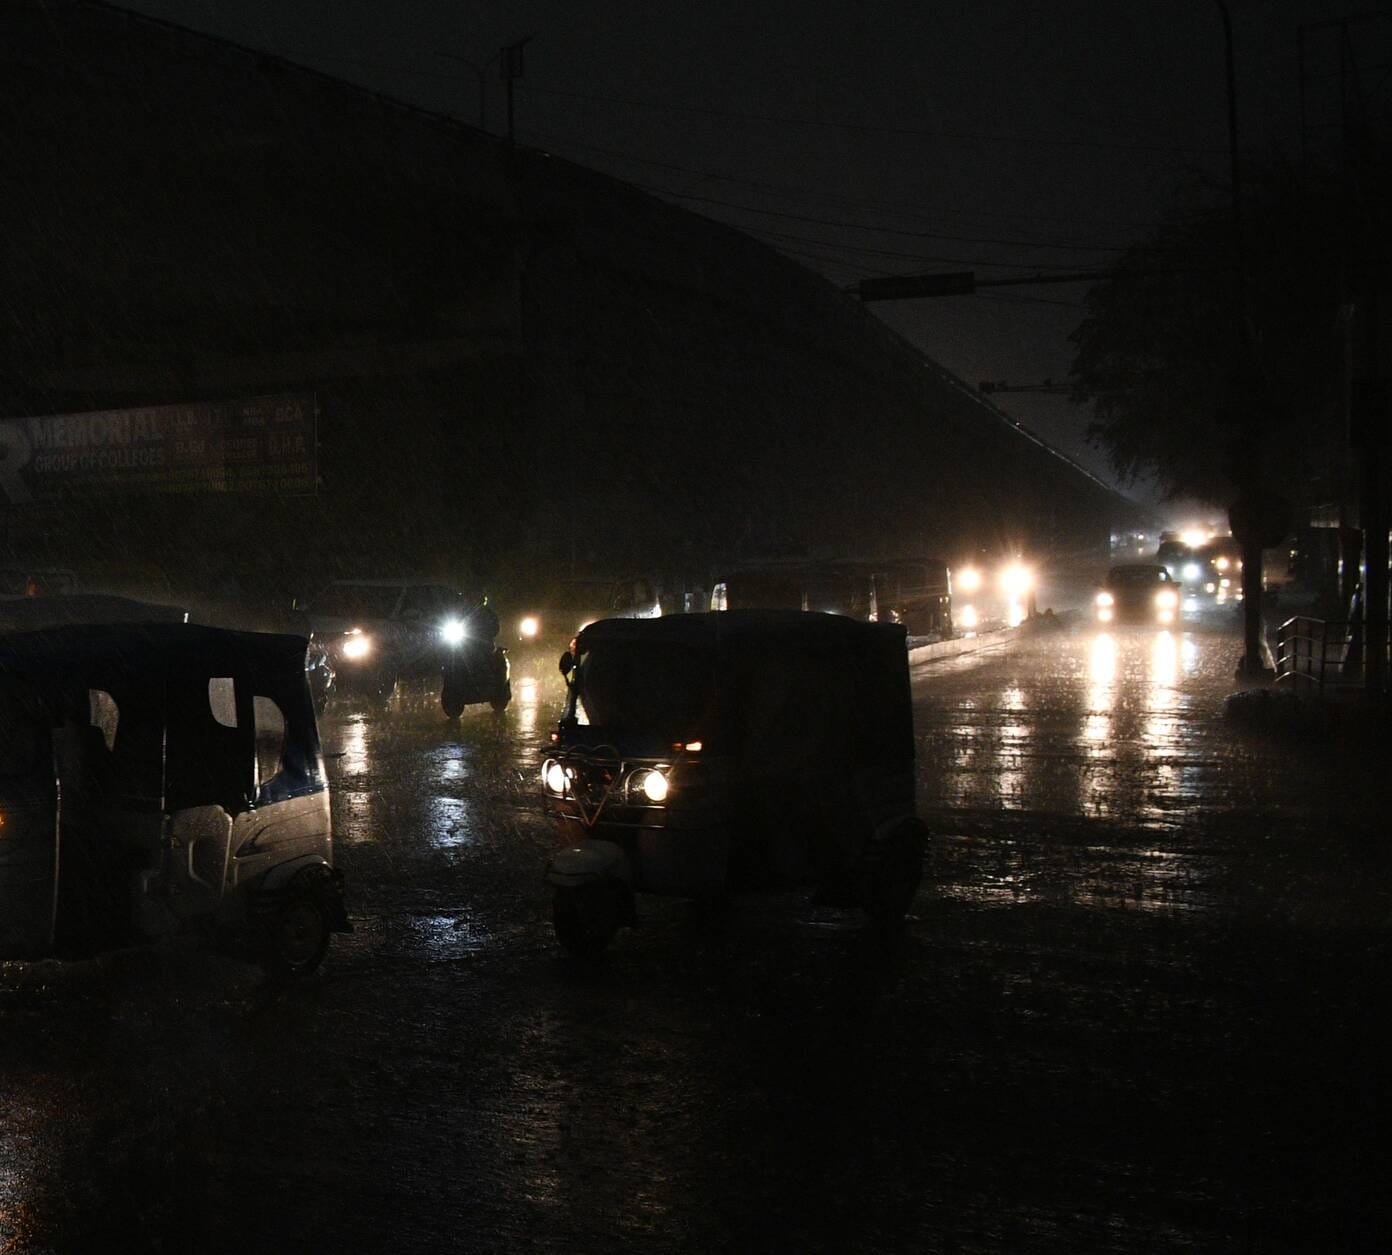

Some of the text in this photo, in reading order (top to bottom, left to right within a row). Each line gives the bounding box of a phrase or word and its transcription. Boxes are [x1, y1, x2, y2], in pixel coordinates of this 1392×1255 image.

[31, 410, 163, 448] MEMORIAL
[34, 448, 166, 472] GROUP OF COLLEGES
